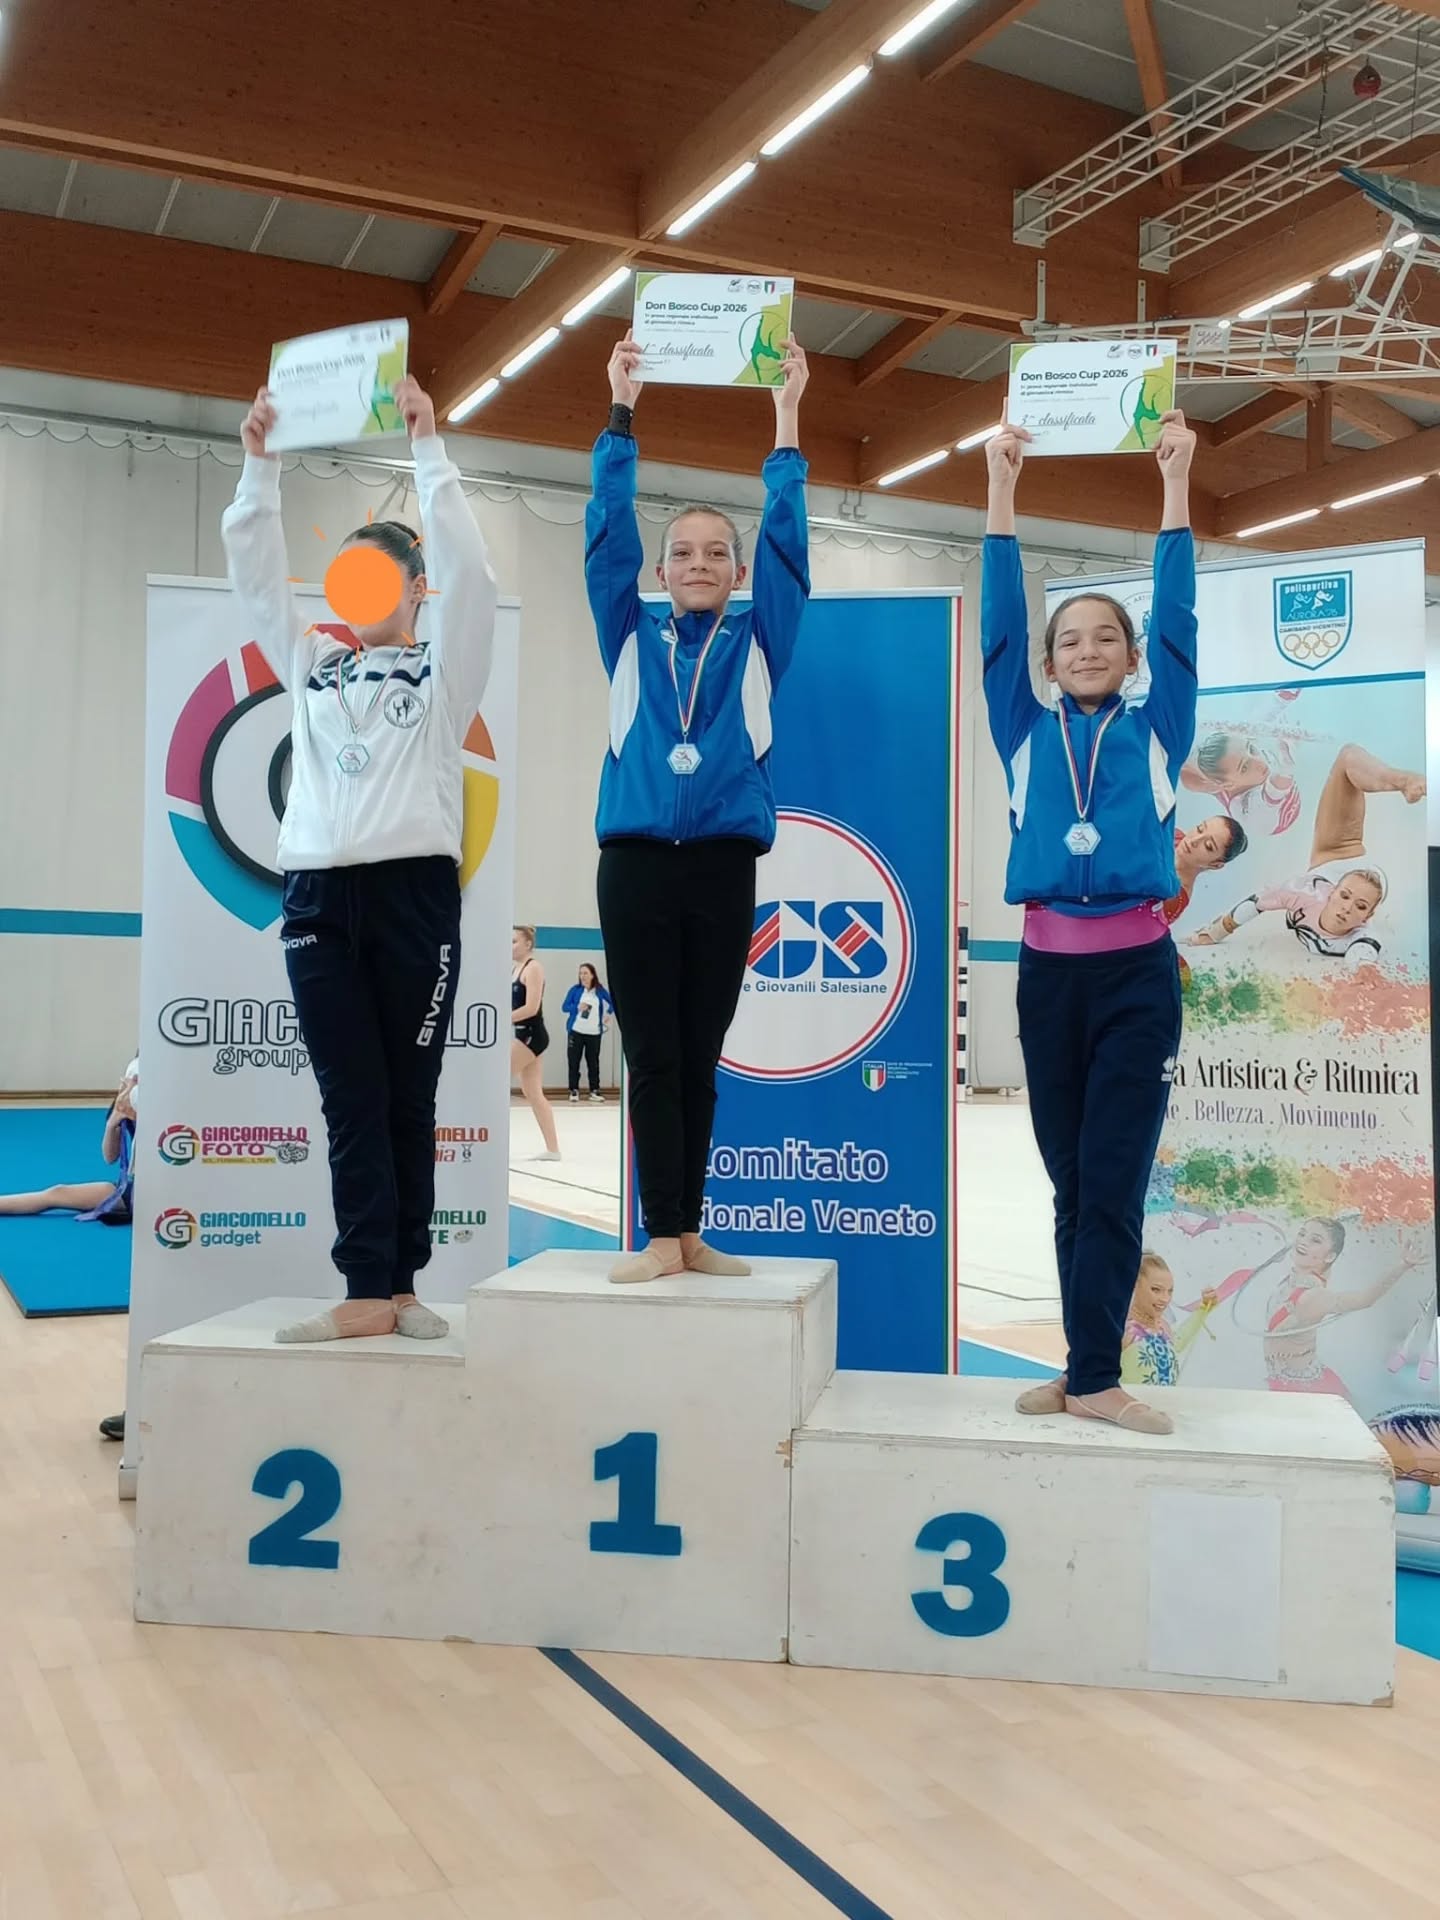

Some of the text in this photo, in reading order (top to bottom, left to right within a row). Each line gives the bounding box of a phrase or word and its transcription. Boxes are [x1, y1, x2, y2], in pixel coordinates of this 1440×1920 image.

[645, 301, 748, 313] Don Bosco Cup 2026
[1020, 369, 1128, 381] Don Bosco Cup 2026
[1038, 412, 1096, 431] classificata
[416, 944, 452, 1047] GIVOVA
[756, 980, 816, 993] Giovanili
[820, 981, 887, 994] Salesiane
[213, 1046, 311, 1075] group
[1192, 1056, 1288, 1091] Artistica
[1294, 1057, 1318, 1092] &
[1325, 1058, 1420, 1095] Ritmica
[1195, 1099, 1264, 1125] Bellezza
[1280, 1103, 1377, 1130] Movimento
[202, 1126, 308, 1142] GIACOMELLO
[202, 1143, 265, 1156] FOTO
[706, 1137, 888, 1183] omitato
[201, 1211, 306, 1228] GIACOMELLO
[811, 1199, 937, 1236] Veneto
[201, 1230, 261, 1247] gadget
[249, 1448, 341, 1568] 2
[590, 1432, 682, 1556] 1
[911, 1511, 1010, 1637] 3
